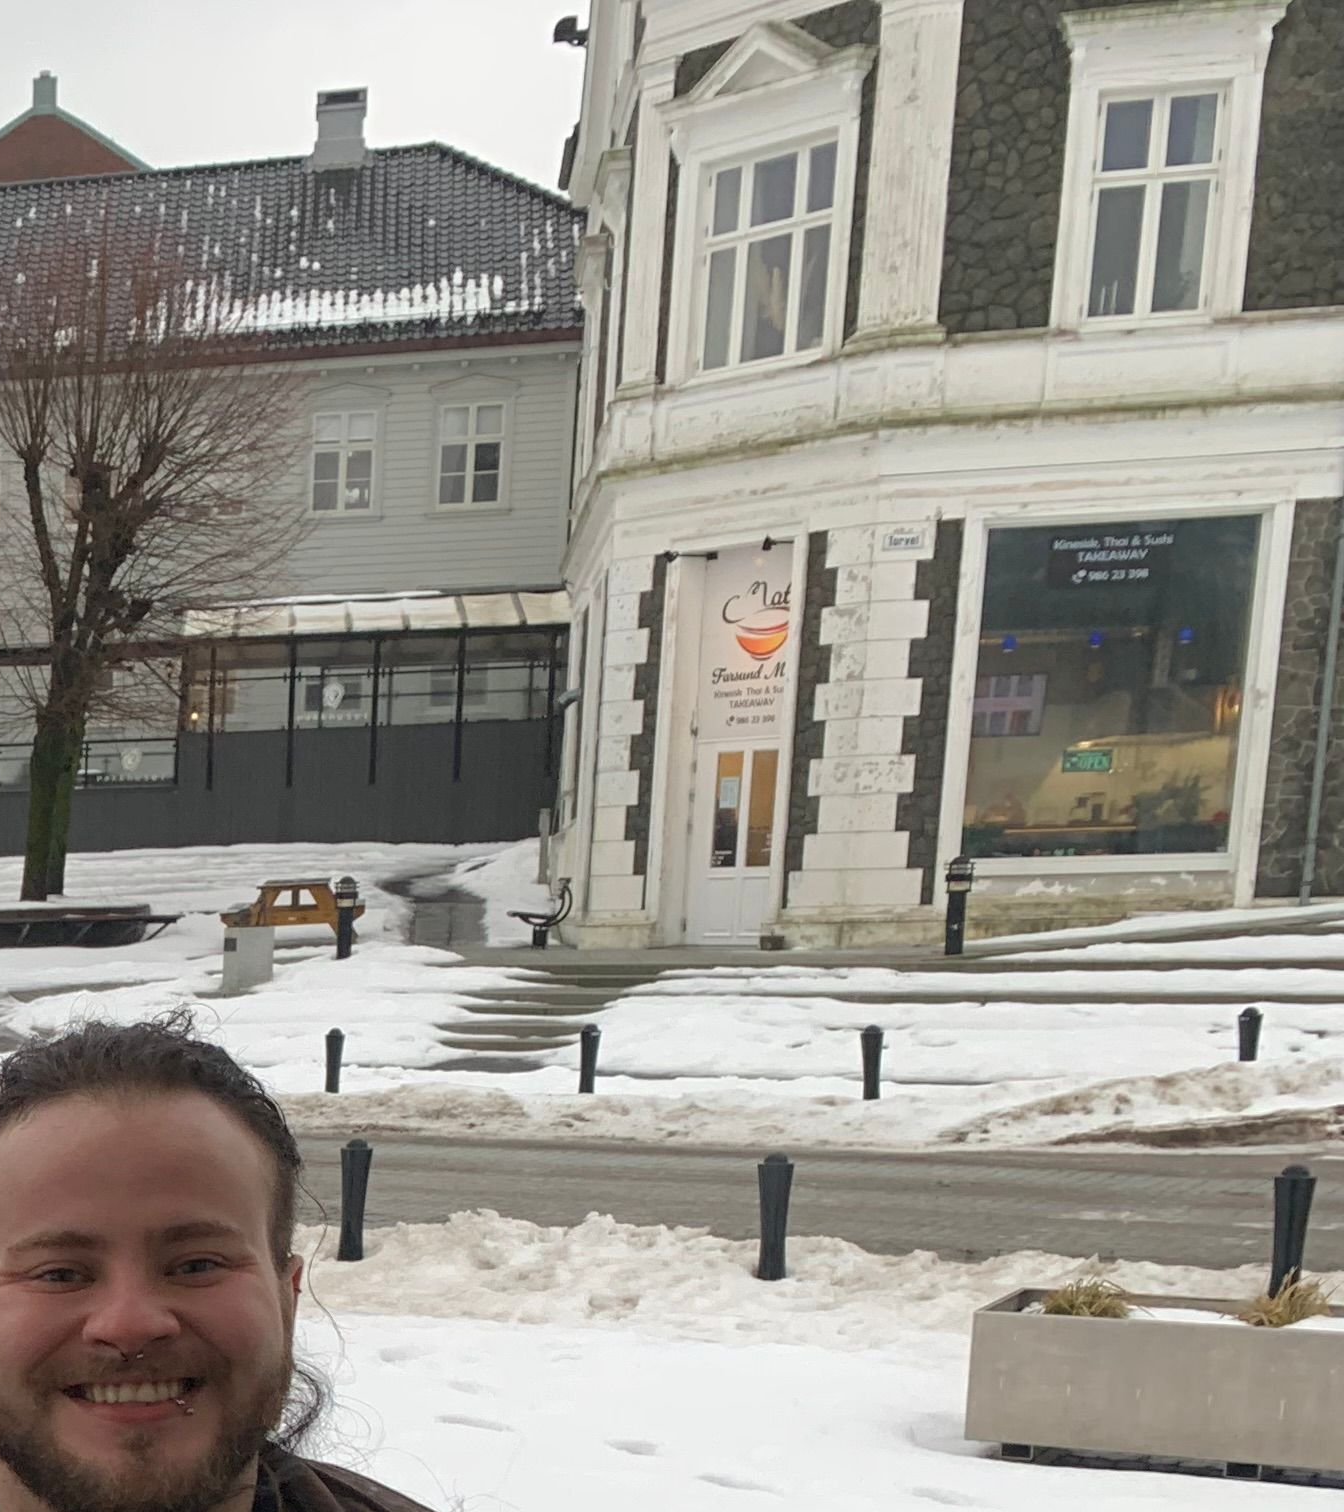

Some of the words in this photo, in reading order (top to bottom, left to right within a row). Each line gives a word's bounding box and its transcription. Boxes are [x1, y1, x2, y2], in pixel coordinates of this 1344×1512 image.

[1132, 535, 1142, 546] &
[1078, 548, 1148, 562] TAKEAWAY
[712, 664, 764, 685] Farsund
[729, 697, 775, 709] TAKEAWAY
